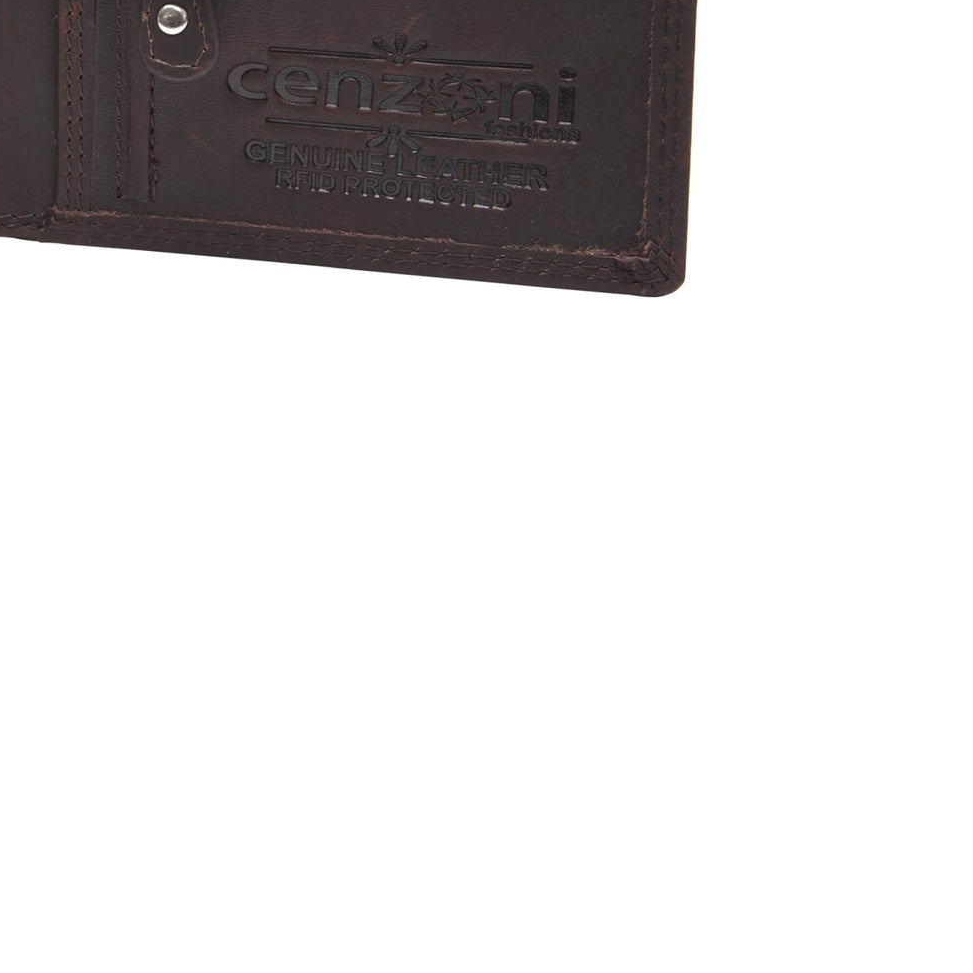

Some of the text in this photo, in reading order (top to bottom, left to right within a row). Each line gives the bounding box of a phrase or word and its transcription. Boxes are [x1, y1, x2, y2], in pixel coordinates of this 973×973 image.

[483, 118, 581, 144] fashions
[244, 139, 549, 191] GENUINE LEATHER
[274, 167, 513, 211] RFID PROTECTED
